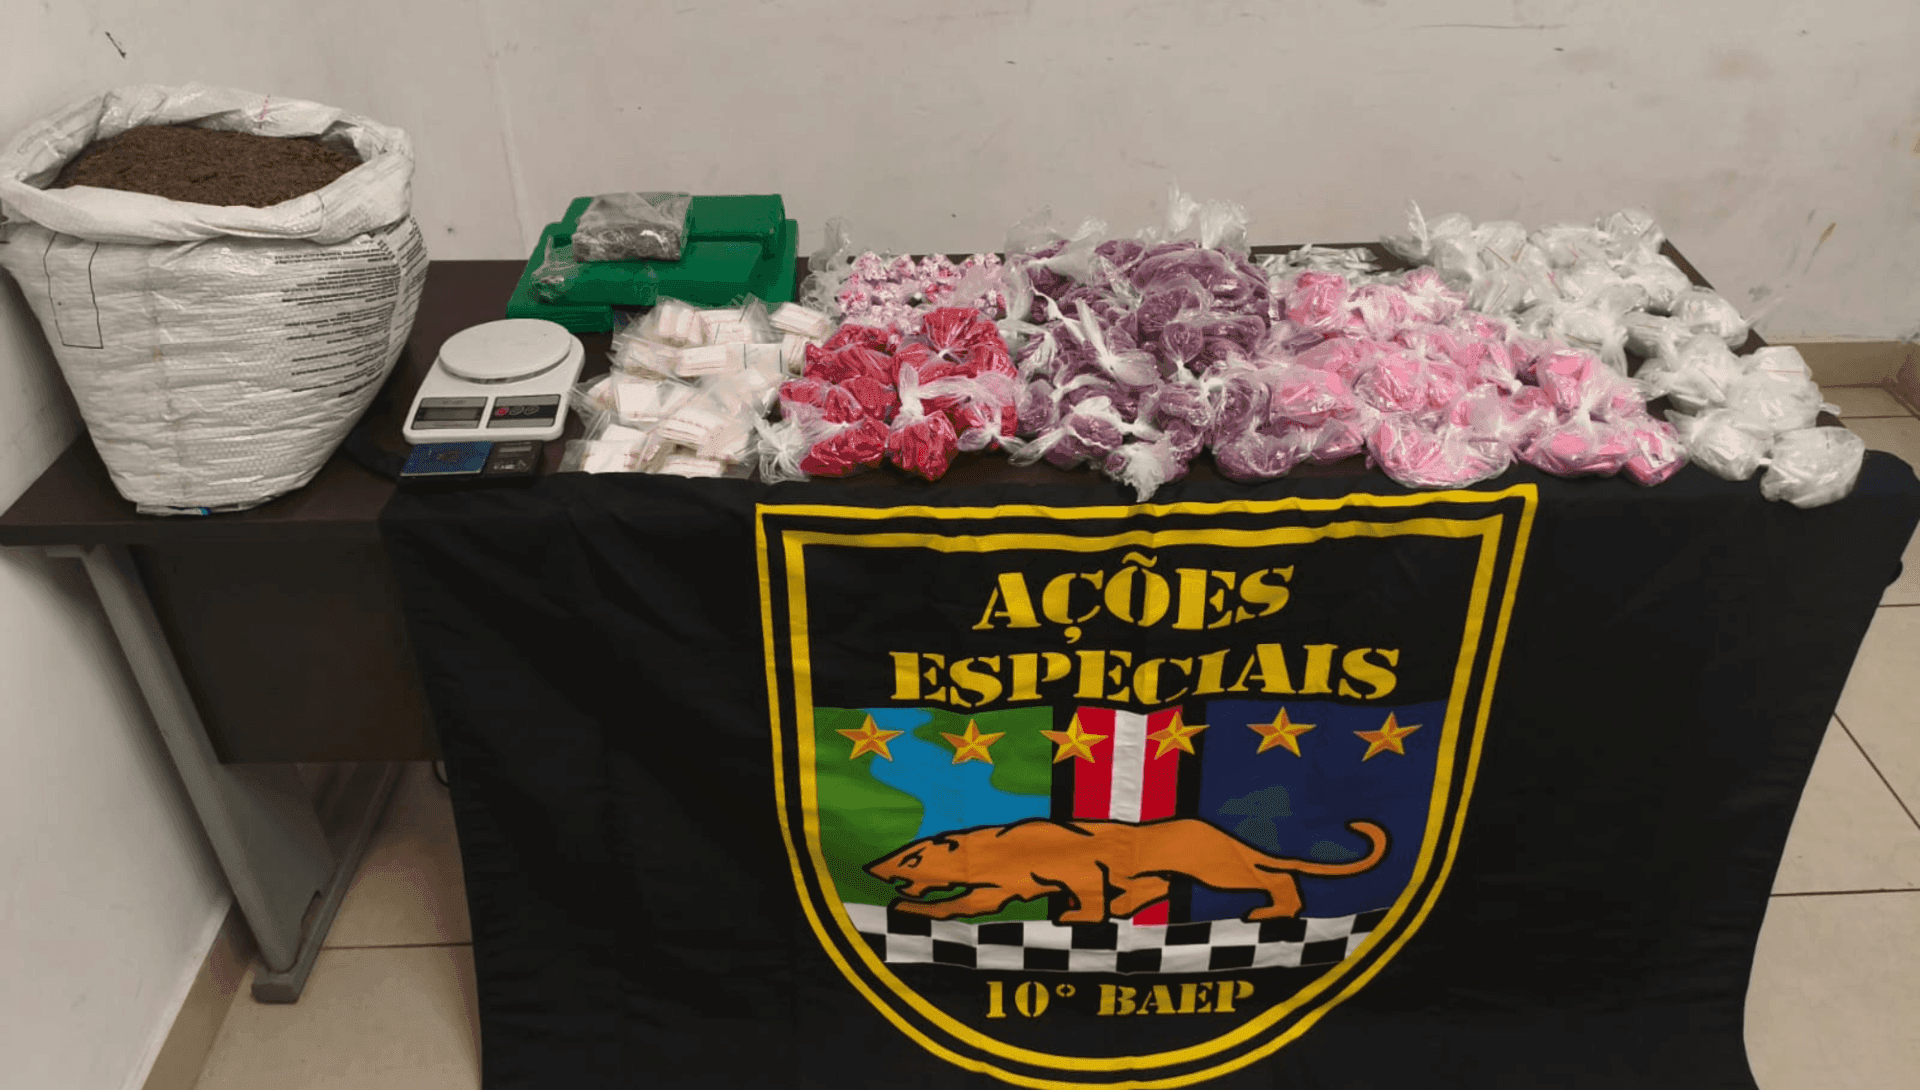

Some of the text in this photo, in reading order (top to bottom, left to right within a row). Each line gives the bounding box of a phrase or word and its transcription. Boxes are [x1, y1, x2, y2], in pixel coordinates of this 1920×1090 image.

[972, 551, 1295, 645] AÇÕES
[888, 643, 1401, 708] ESPECIAIS
[1096, 979, 1255, 1017] BAEP
